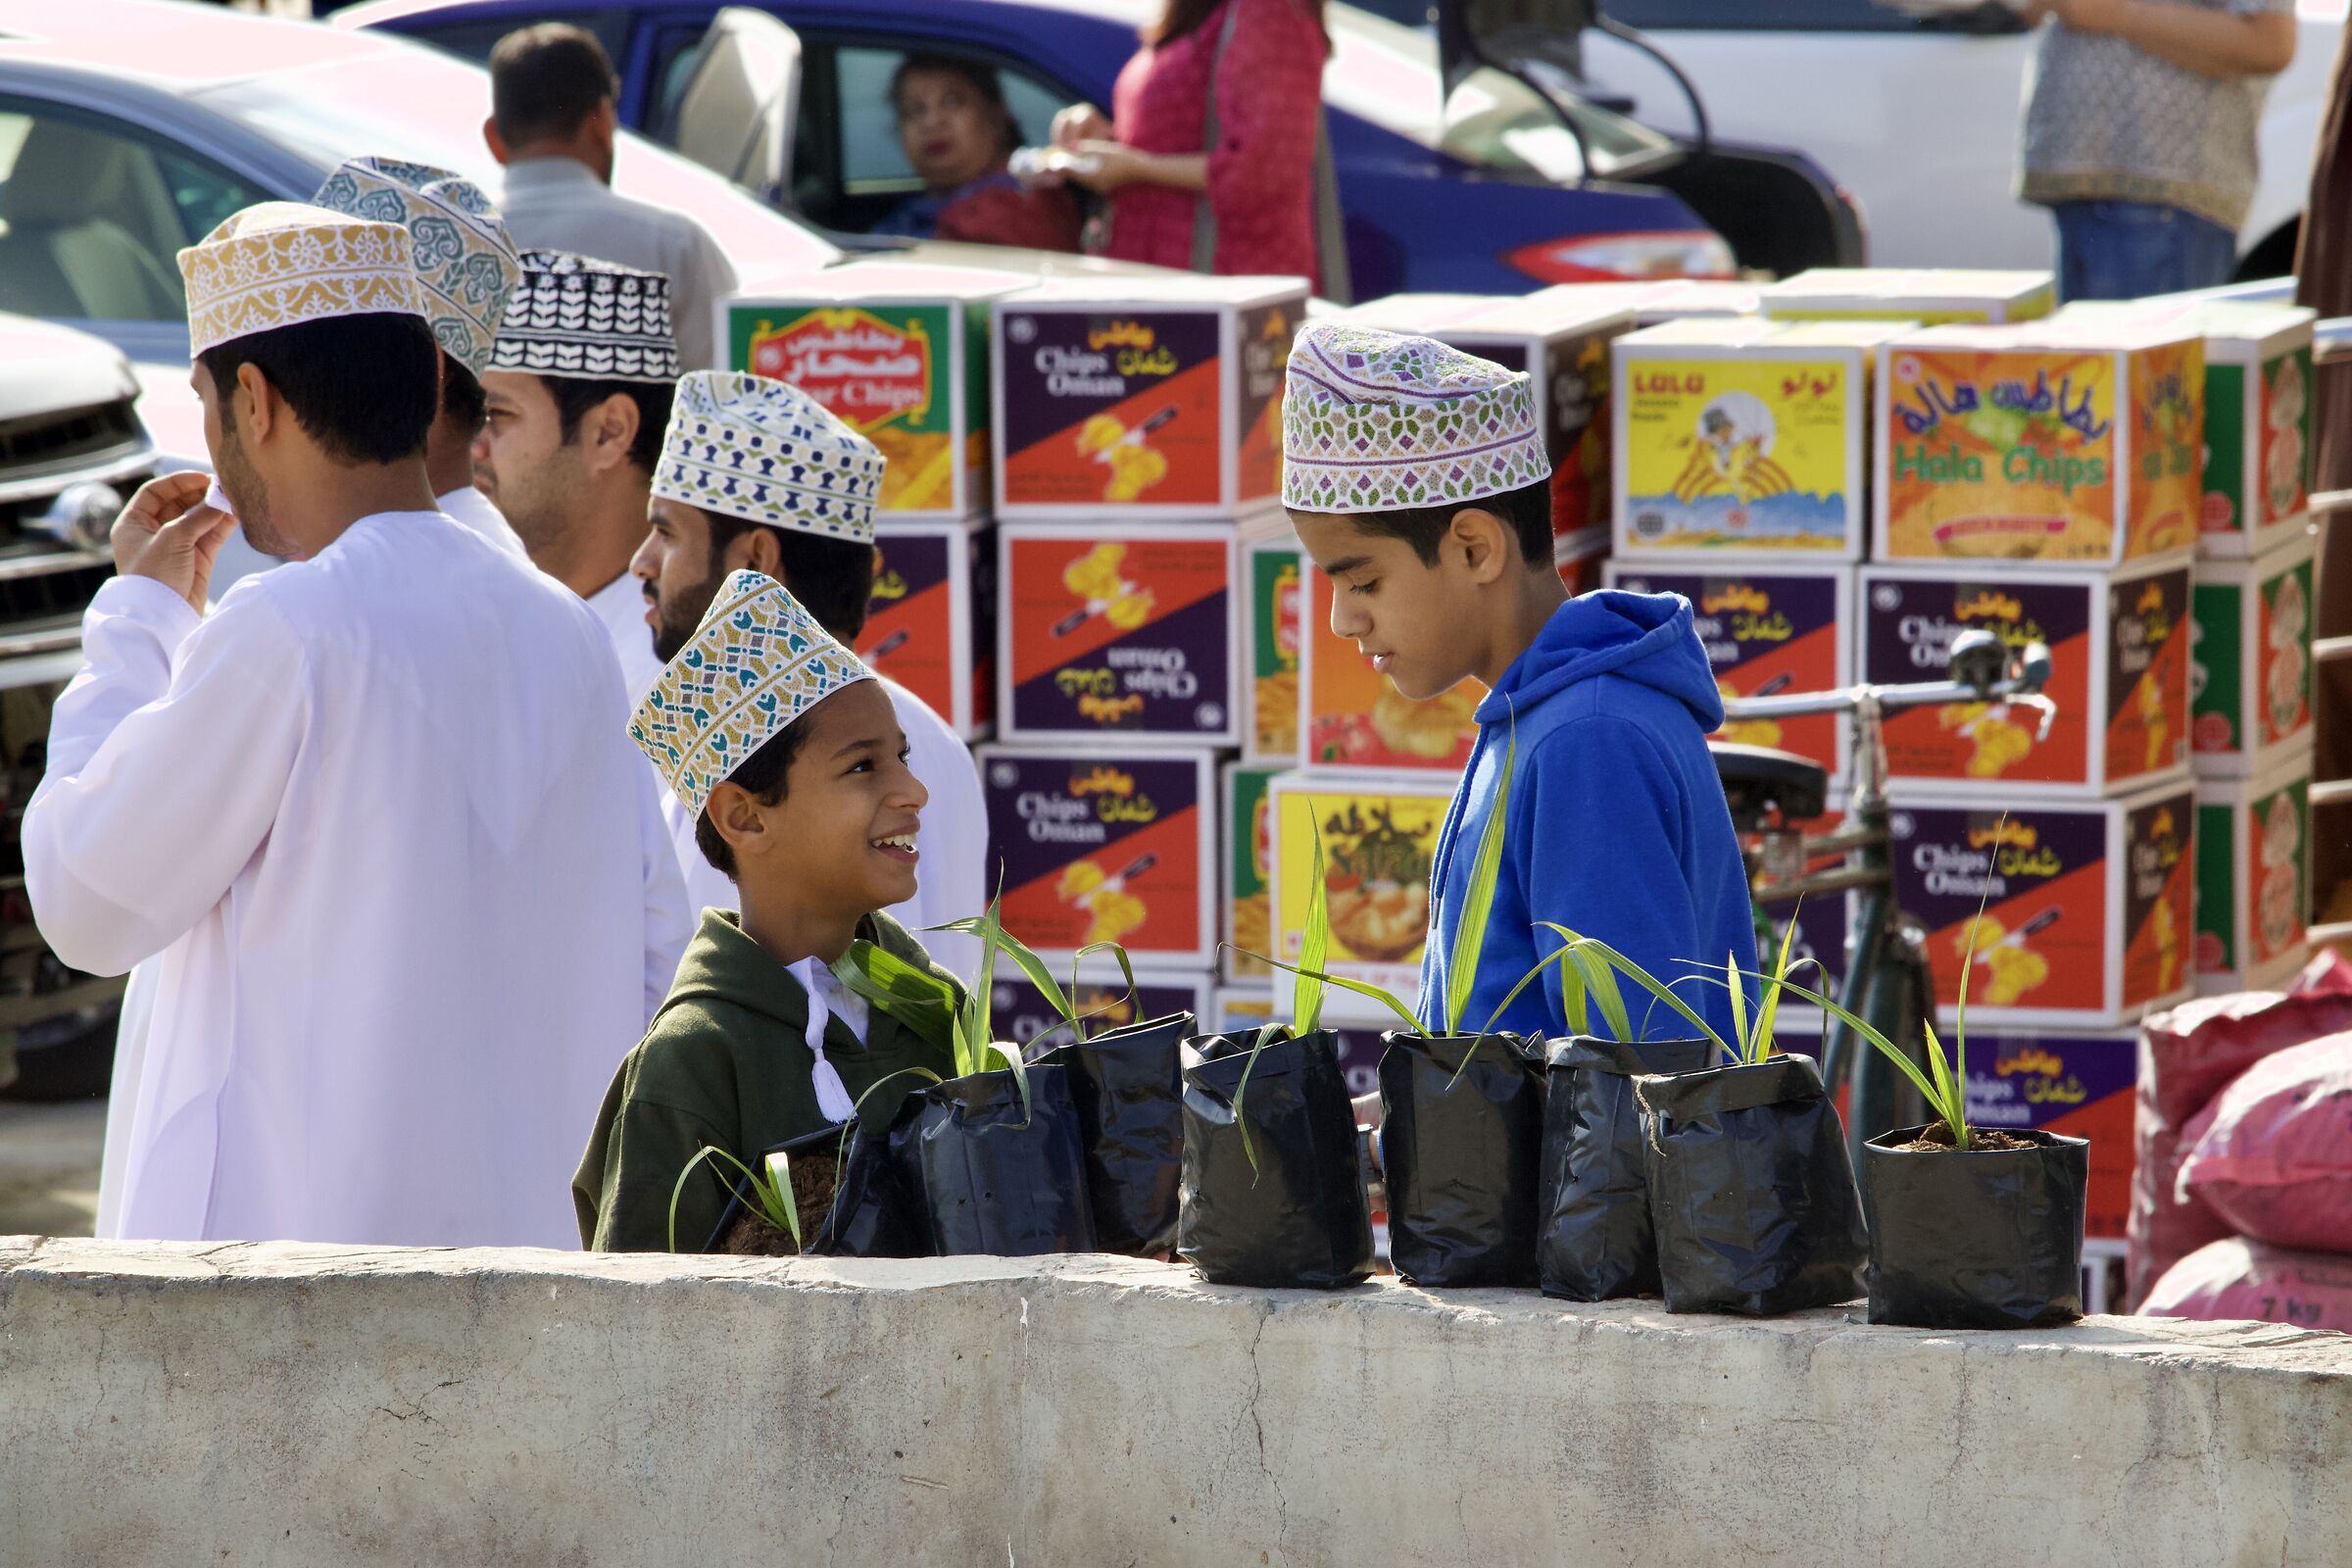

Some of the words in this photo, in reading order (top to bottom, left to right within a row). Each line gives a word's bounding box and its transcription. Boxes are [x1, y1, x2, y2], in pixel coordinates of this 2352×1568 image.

[1035, 345, 1109, 376] Chips
[1046, 370, 1126, 397] Oman
[1894, 441, 1984, 484] Hala
[2001, 444, 2107, 498] Chips
[1124, 669, 1199, 699] Chips
[1015, 791, 1090, 820] Chips
[1028, 818, 1106, 844] Oman
[1914, 843, 1990, 874] Chips
[1925, 870, 2007, 897] Oman
[2258, 1296, 2277, 1318] 7
[2286, 1296, 2322, 1325] kg
